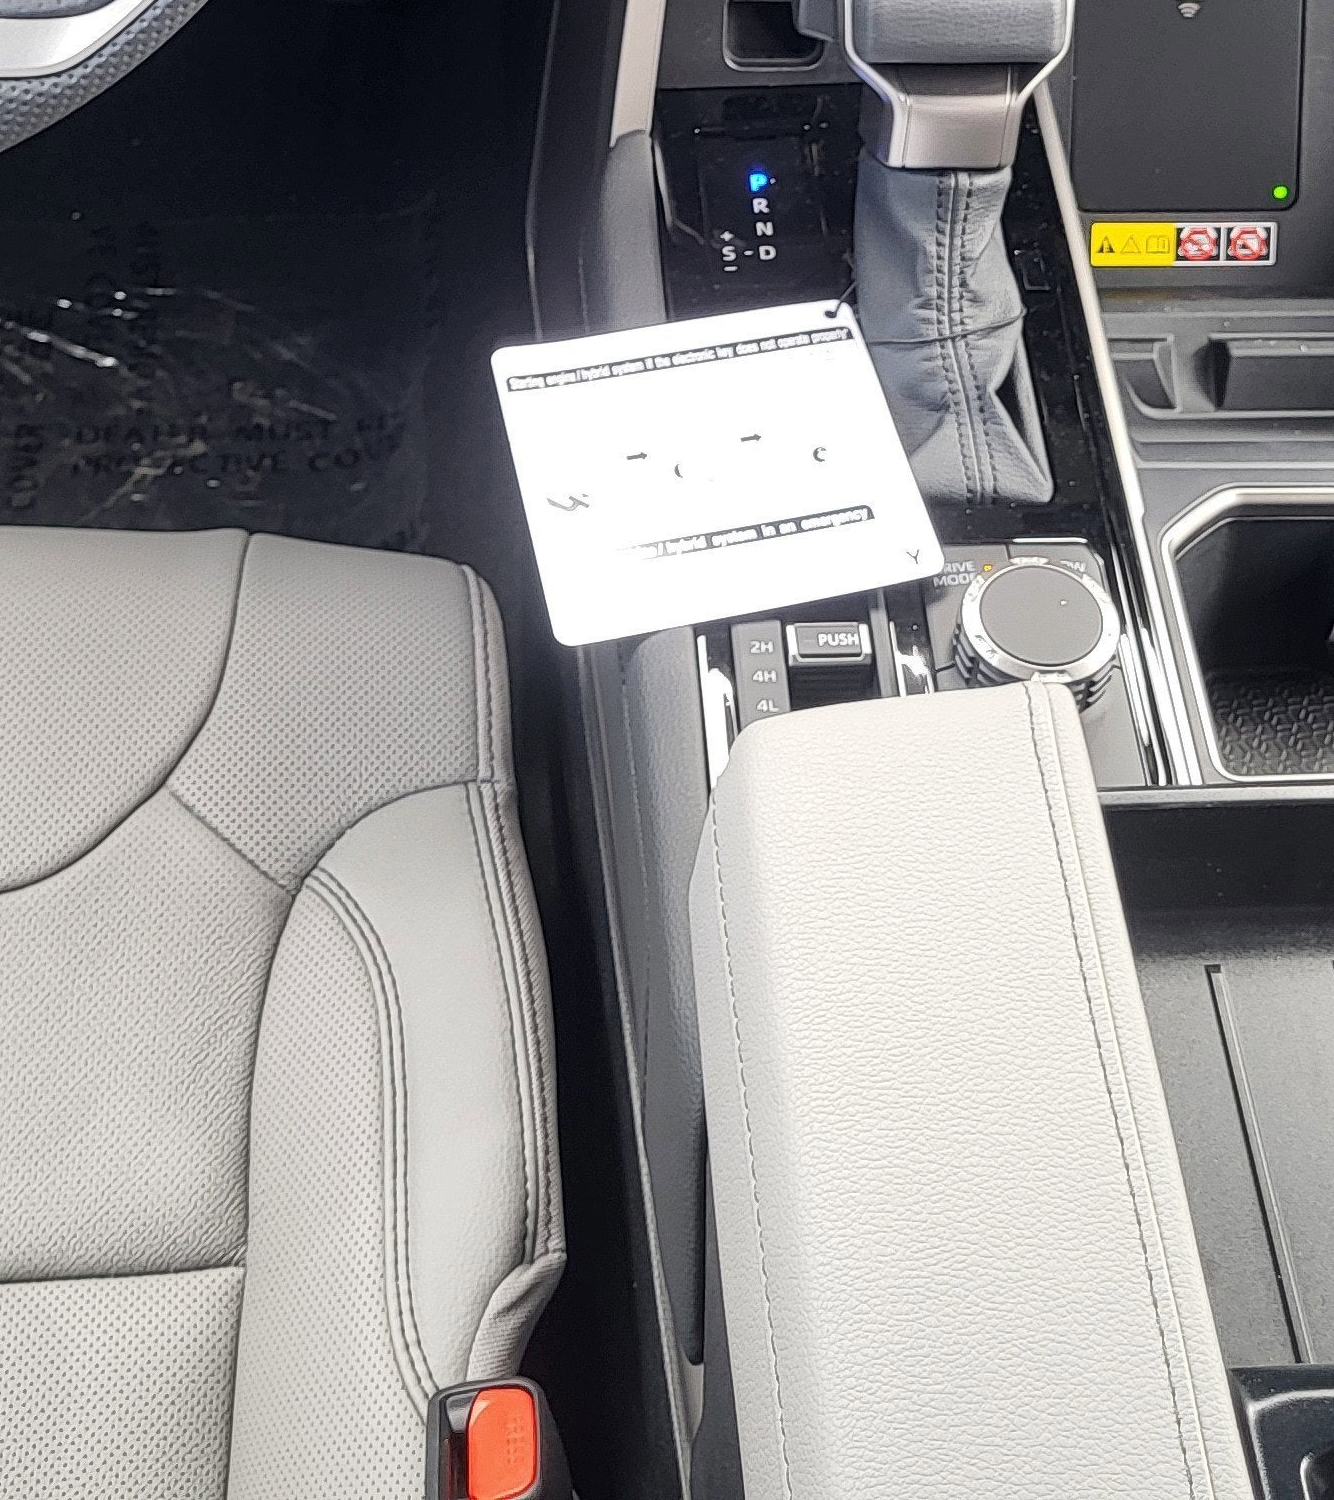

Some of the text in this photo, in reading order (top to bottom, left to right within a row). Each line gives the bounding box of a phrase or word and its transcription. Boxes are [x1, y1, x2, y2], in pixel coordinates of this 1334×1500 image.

[749, 172, 768, 193] P
[752, 197, 770, 214] R
[755, 221, 774, 237] N
[721, 245, 777, 262] S D
[941, 560, 977, 574] RIVE
[750, 640, 774, 654] 2H
[817, 632, 860, 647] PUSH
[752, 669, 777, 683] 4H
[756, 699, 780, 713] 4L
